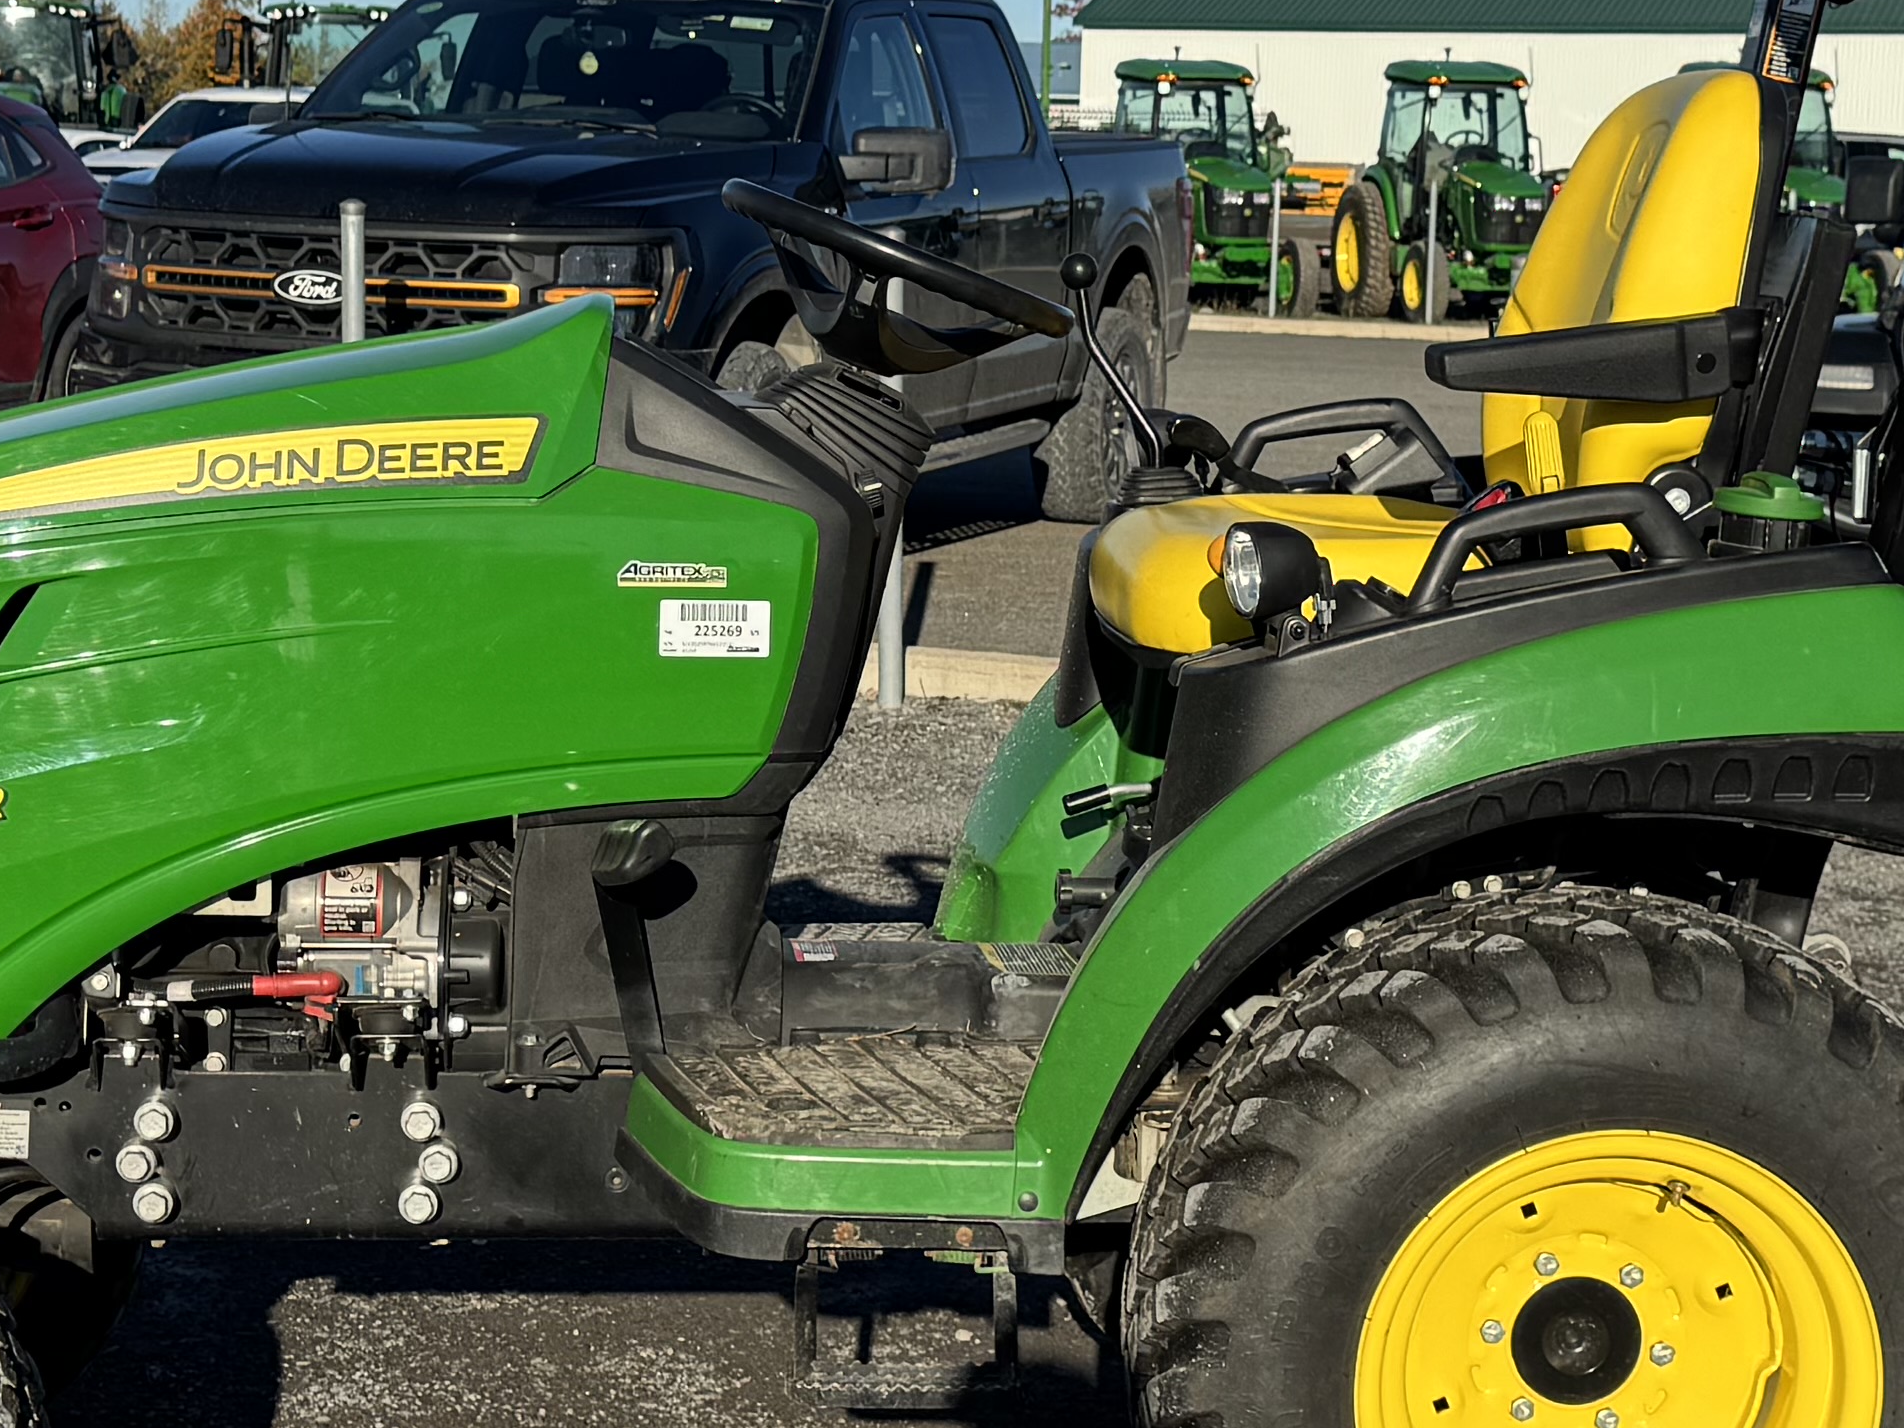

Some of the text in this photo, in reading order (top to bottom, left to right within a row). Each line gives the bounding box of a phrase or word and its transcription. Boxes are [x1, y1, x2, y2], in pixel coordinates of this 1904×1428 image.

[288, 274, 338, 299] Ford
[176, 438, 505, 489] JOHN DEERE
[620, 562, 704, 576] AGRITEX
[694, 625, 743, 637] 225269
